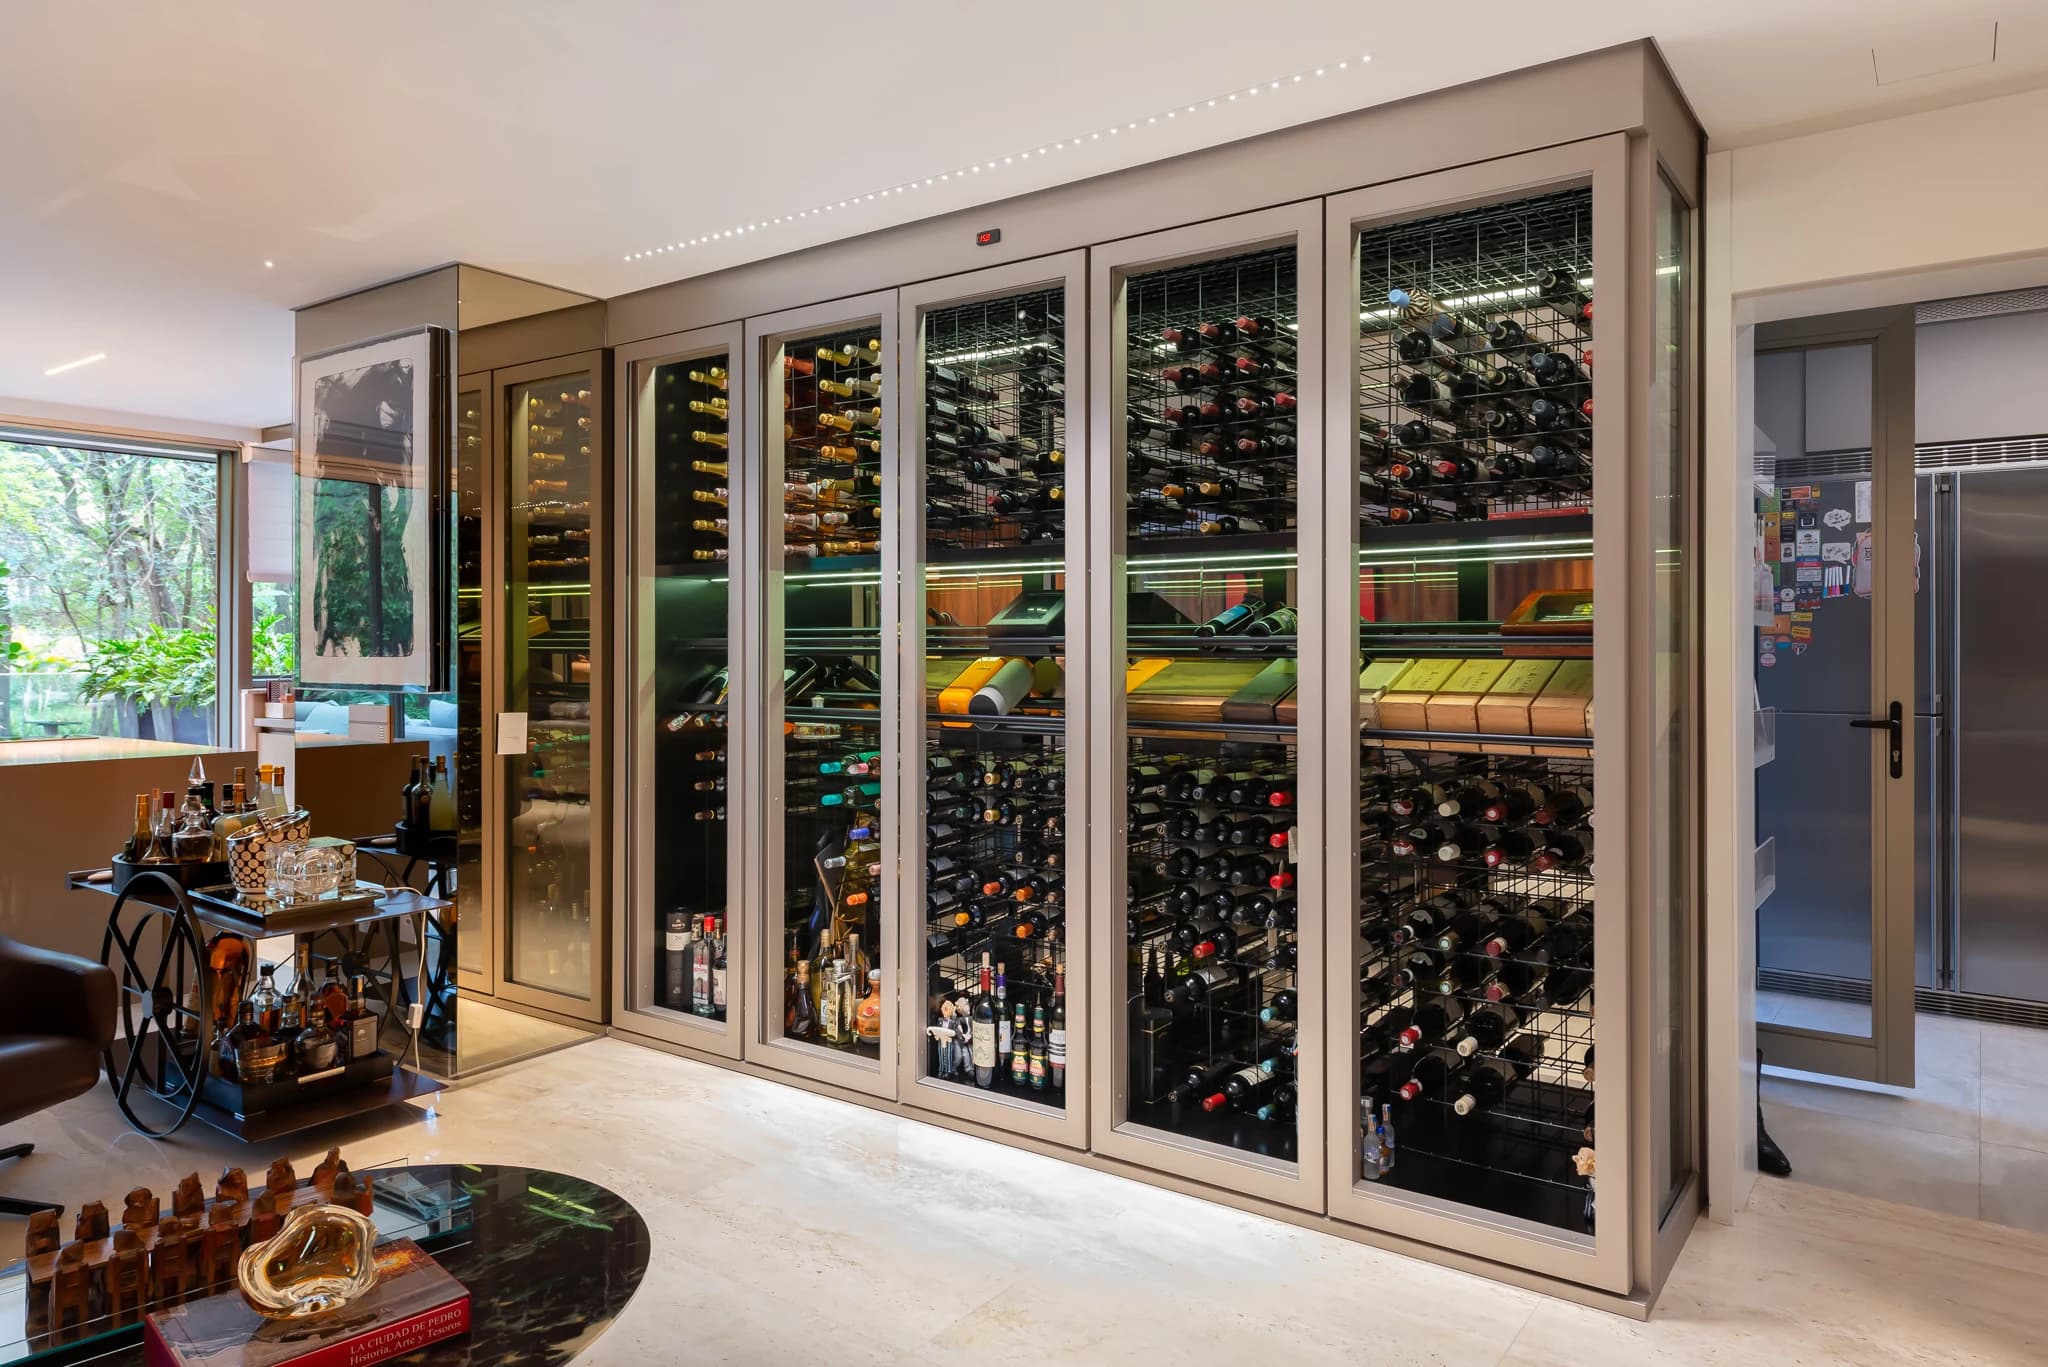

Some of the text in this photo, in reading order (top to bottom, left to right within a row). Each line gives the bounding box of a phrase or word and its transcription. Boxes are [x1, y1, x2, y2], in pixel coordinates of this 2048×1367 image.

[350, 1308, 461, 1354] LA CIUDAD DE PEDRO
[394, 1336, 415, 1350] Arte
[417, 1335, 424, 1344] y
[426, 1321, 462, 1337] Tesoros
